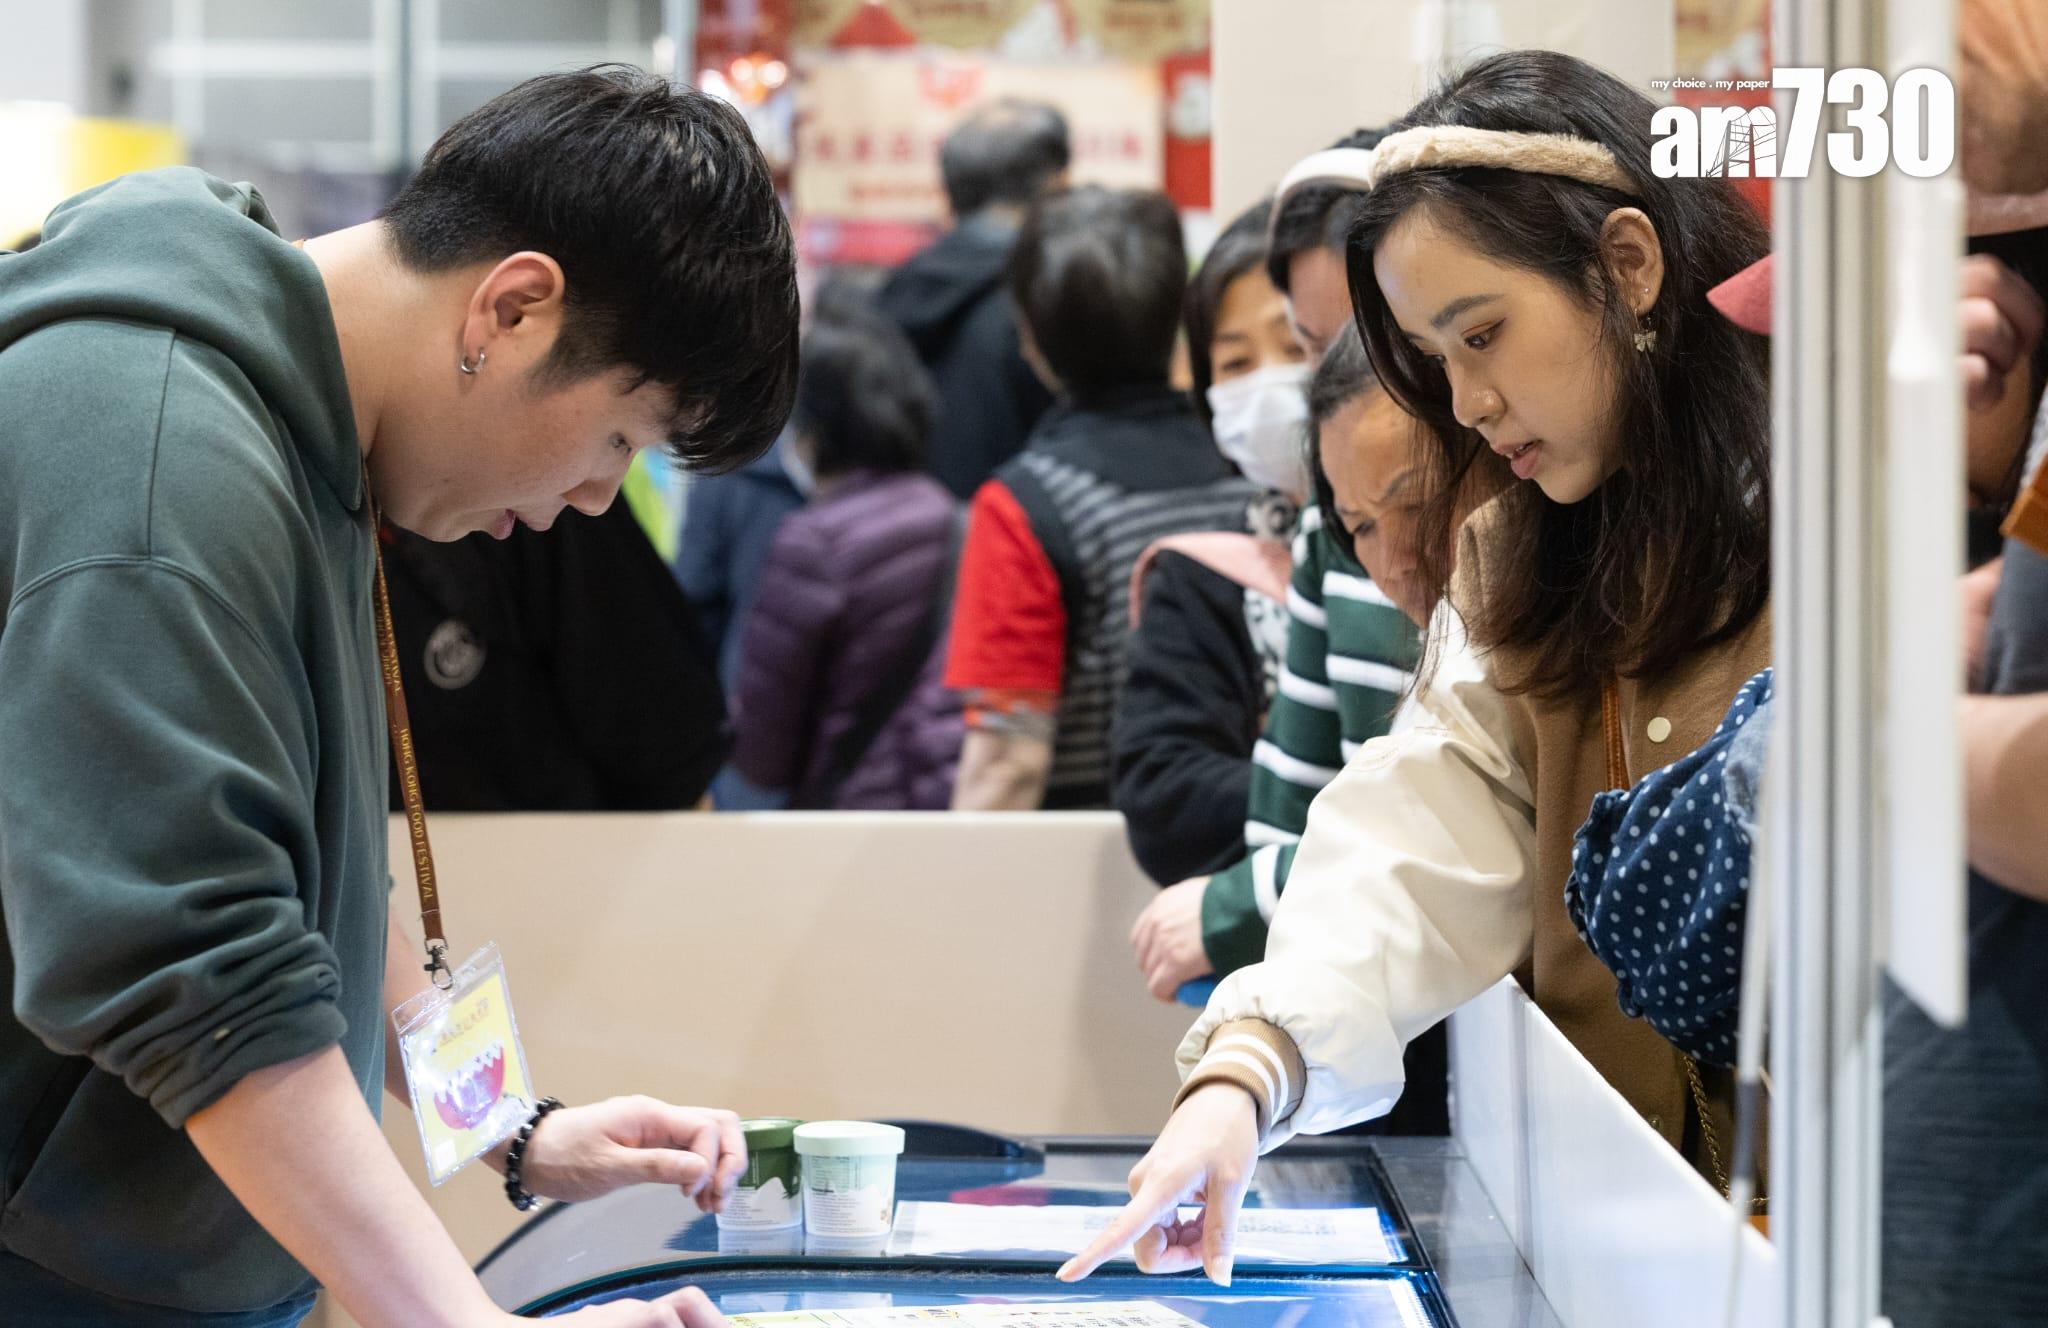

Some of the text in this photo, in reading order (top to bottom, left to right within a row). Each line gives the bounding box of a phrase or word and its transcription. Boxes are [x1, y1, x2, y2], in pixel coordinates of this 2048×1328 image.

[400, 728, 434, 902] HONG KONG FOOD FESTIVAL
